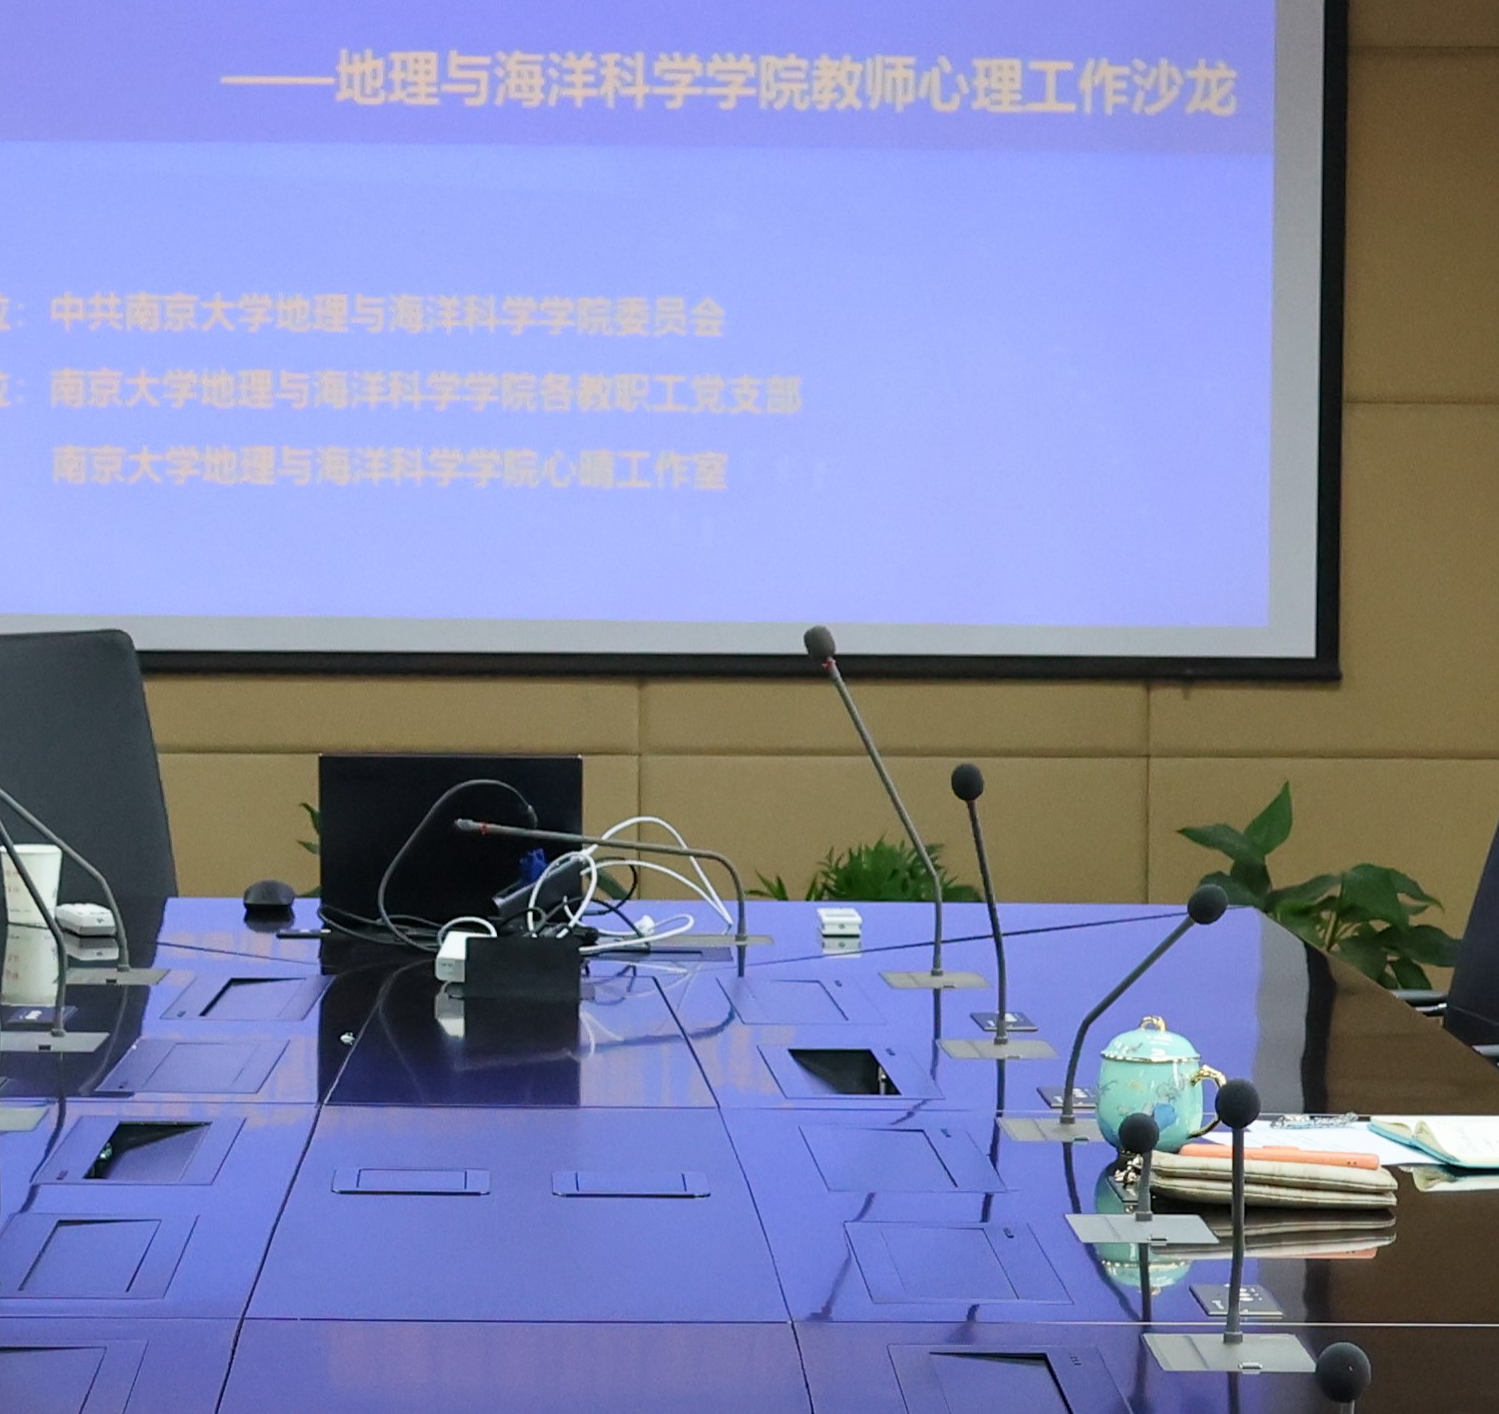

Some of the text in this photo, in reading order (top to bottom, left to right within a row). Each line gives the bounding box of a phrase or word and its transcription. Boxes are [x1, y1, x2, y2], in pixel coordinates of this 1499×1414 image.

[50, 291, 726, 337] 中共南京大学地理与海洋科学学院委员会
[50, 368, 802, 414] 南京大学地理与海洋科学学院各教职工党支部
